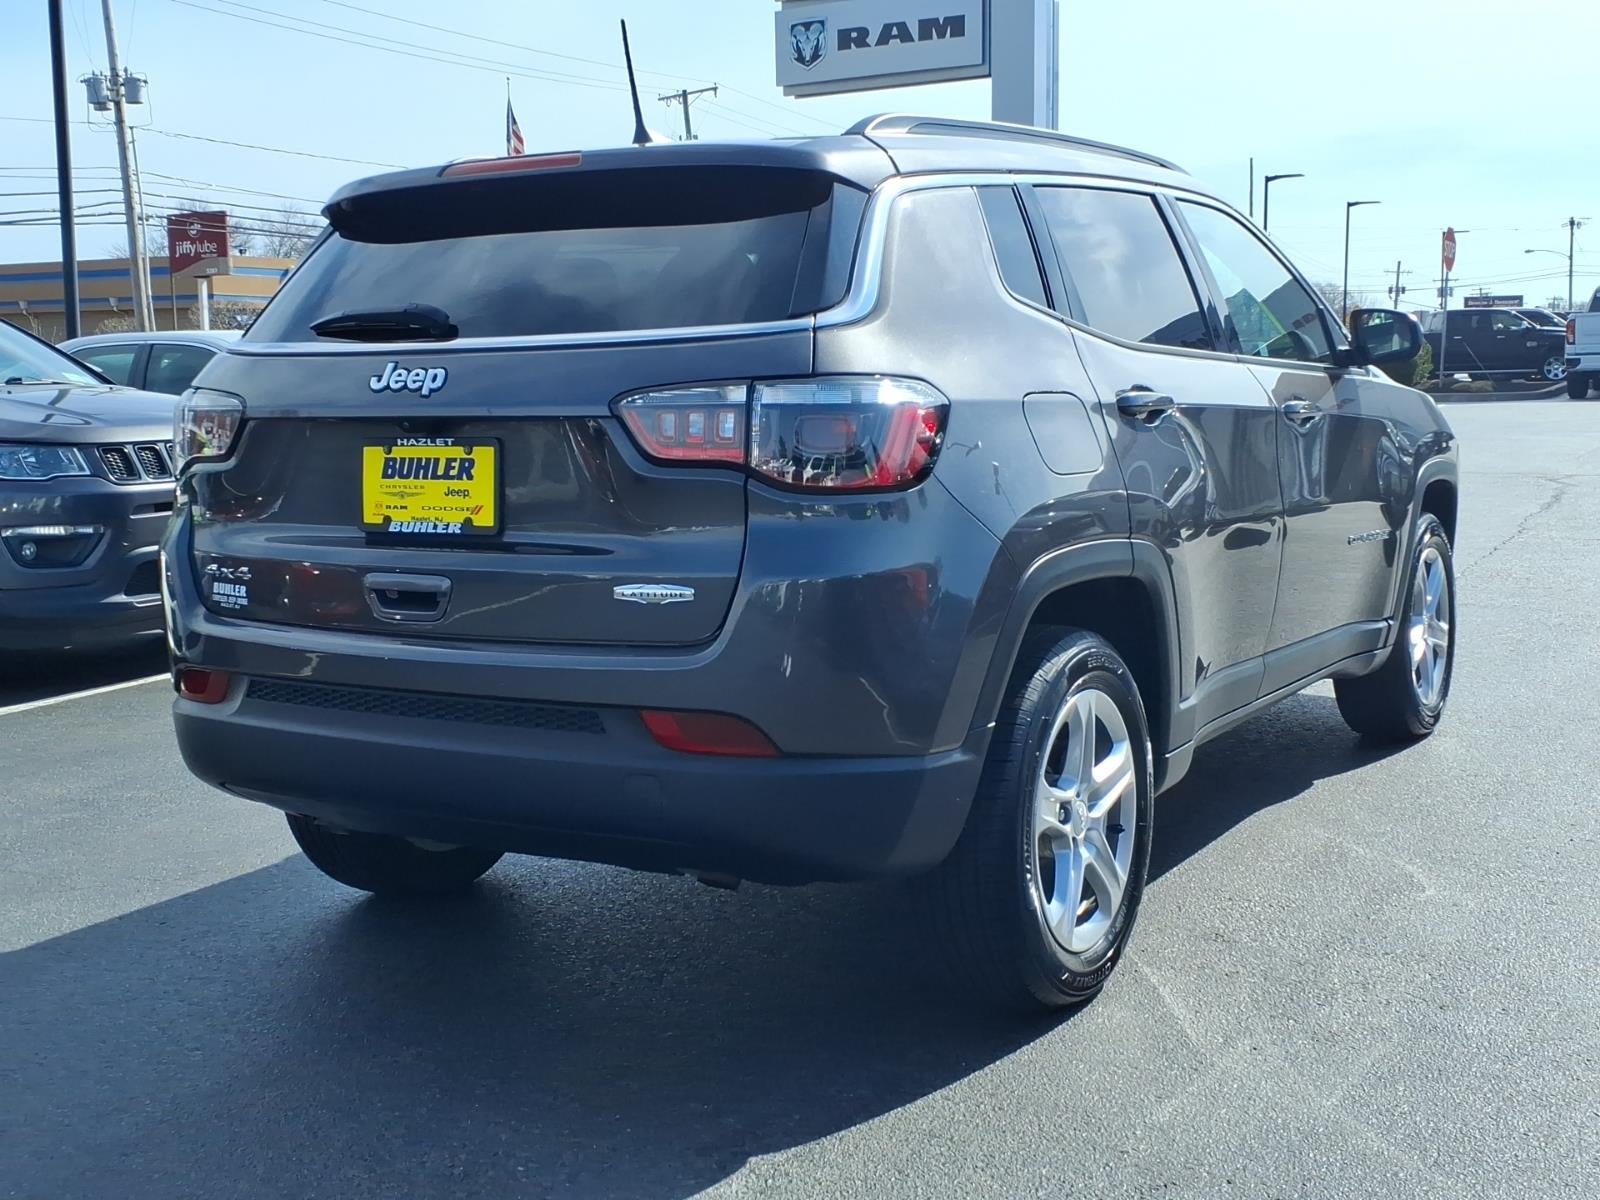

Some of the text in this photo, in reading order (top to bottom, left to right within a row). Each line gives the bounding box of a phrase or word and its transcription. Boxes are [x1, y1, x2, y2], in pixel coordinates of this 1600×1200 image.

[837, 14, 966, 51] RAM
[175, 239, 217, 258] jiffy lube
[369, 361, 447, 398] Jeep
[397, 438, 455, 446] HAZLET
[381, 456, 476, 481] BUHLER
[444, 486, 470, 499] Jeep
[388, 520, 462, 534] BUHLER
[213, 581, 247, 597] BUHLER
[619, 590, 688, 599] LATITUDE
